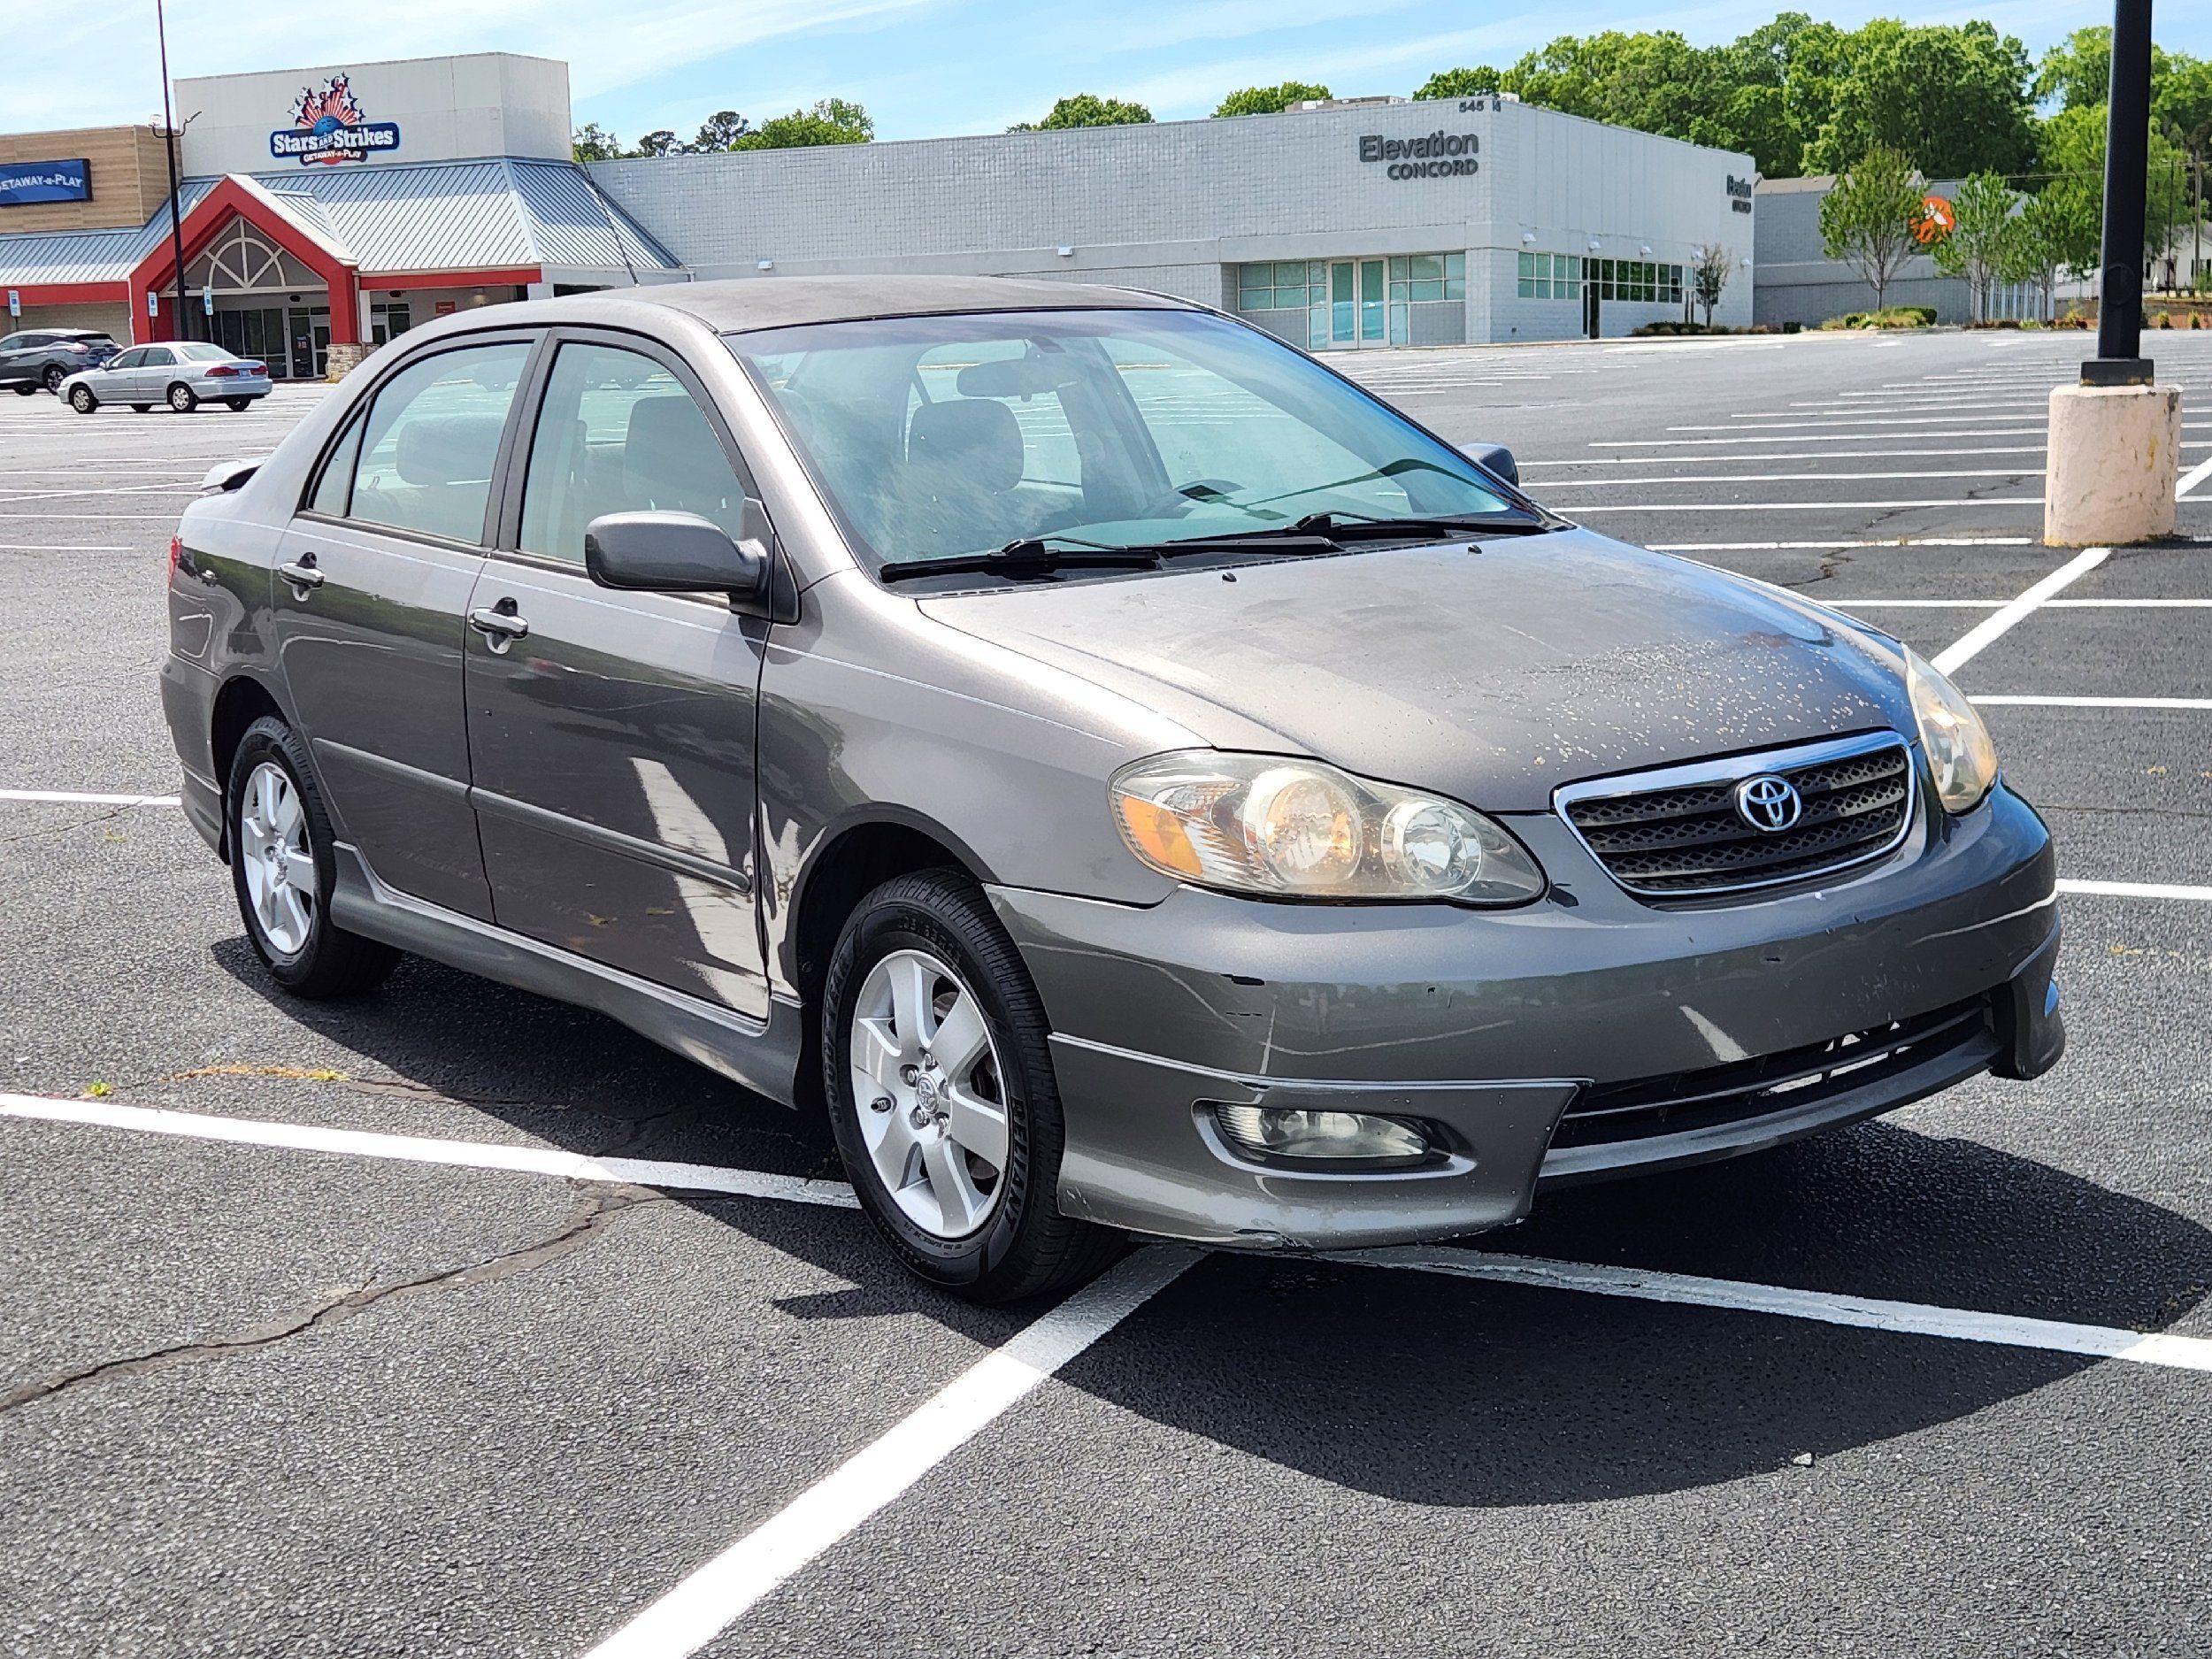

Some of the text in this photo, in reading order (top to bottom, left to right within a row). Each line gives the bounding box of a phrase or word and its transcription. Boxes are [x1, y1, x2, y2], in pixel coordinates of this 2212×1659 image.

[1459, 100, 1485, 113] 545
[273, 134, 318, 153] Stars
[334, 127, 394, 148] Strikes
[1359, 130, 1479, 162] Elevation
[1387, 158, 1479, 180] CONCORD
[1003, 1096, 1028, 1232] RELIANT
